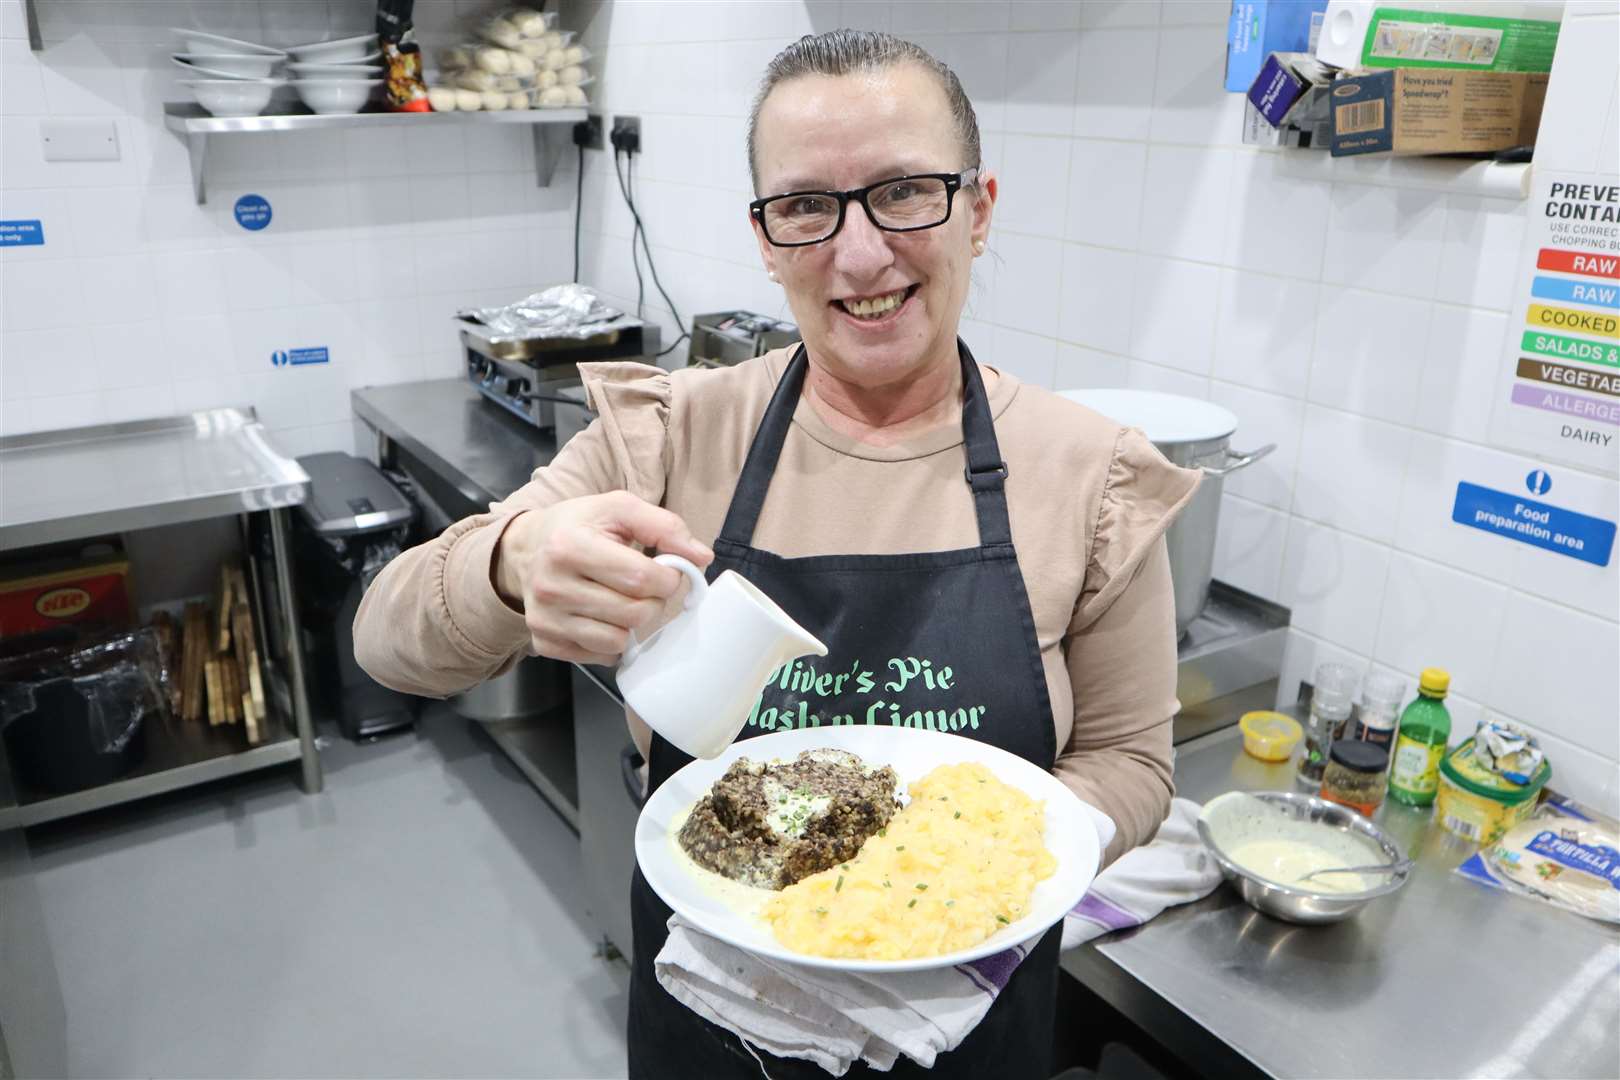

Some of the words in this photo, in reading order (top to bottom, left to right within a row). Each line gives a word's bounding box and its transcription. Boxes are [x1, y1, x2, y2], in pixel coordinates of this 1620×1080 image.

[1545, 202, 1620, 223] CONTA
[1550, 223, 1571, 234] USE
[1551, 235, 1607, 249] CHOPPING
[1573, 256, 1617, 275] RAW
[1572, 285, 1616, 304] RAW
[1540, 309, 1617, 334] COOKED
[1535, 336, 1604, 360] SALADS
[1606, 348, 1619, 363] &
[1542, 394, 1620, 421] ALLERGE
[1560, 425, 1612, 447] DAIRY
[1514, 504, 1550, 523] Food
[1475, 510, 1551, 541] preparation
[1553, 532, 1585, 551] area
[884, 656, 955, 693] Pie
